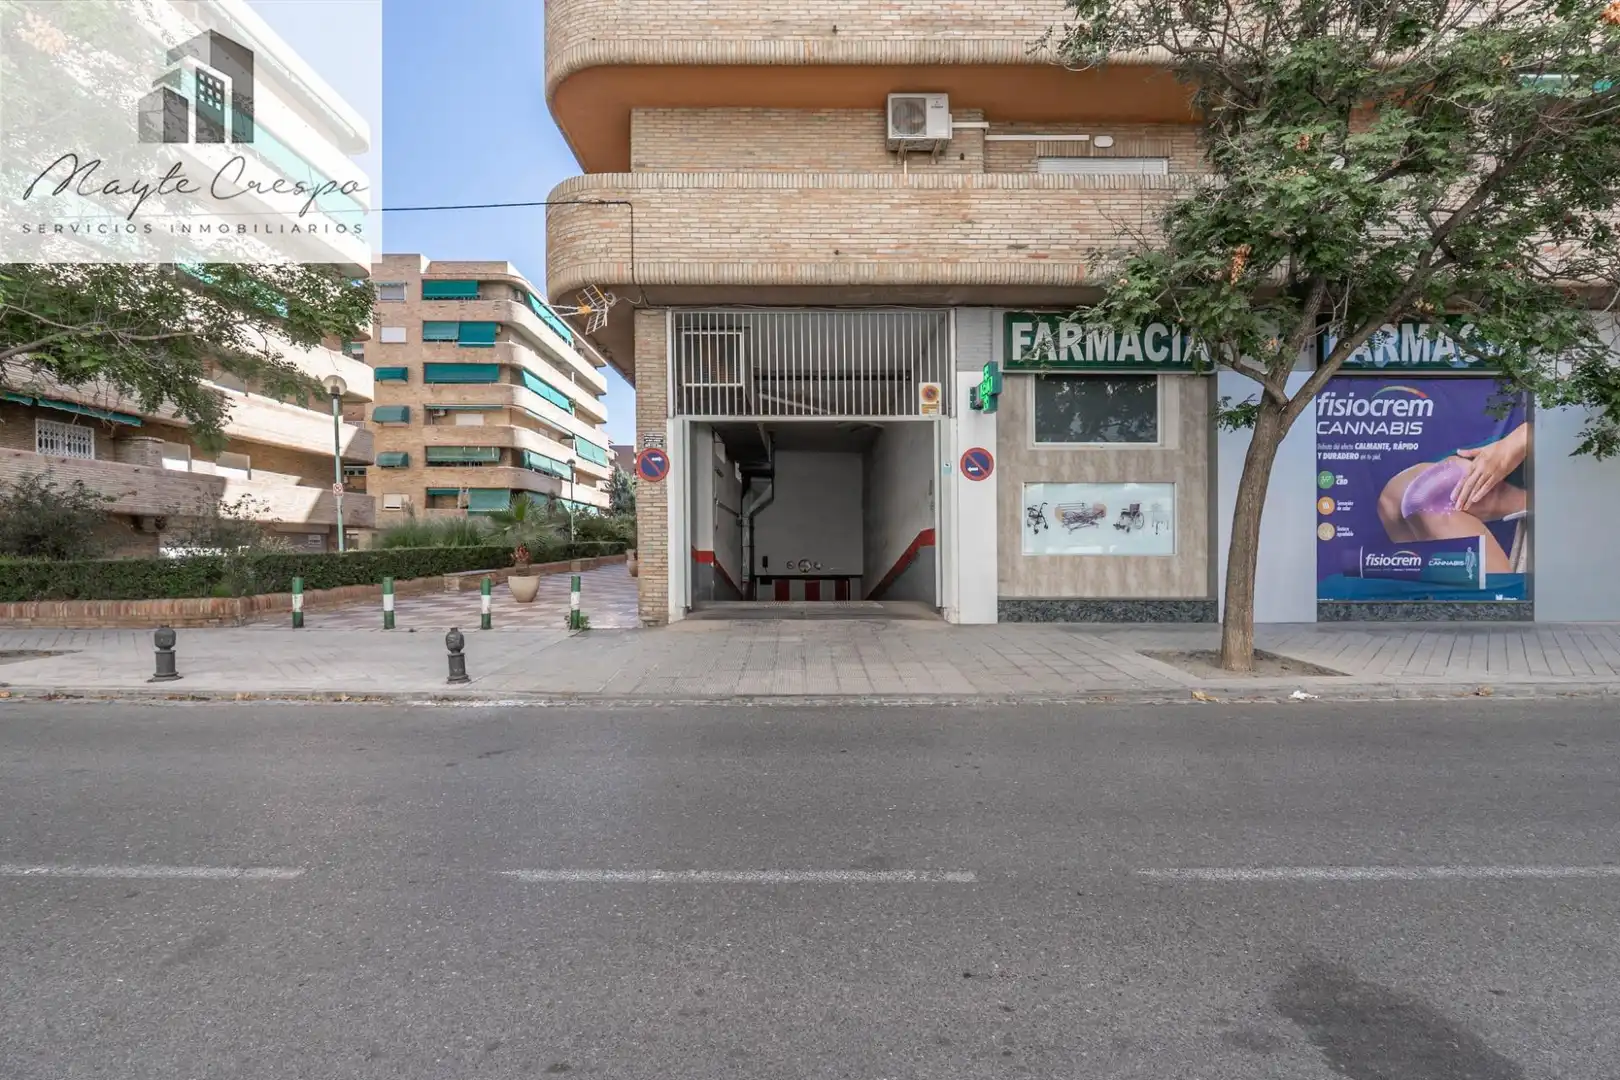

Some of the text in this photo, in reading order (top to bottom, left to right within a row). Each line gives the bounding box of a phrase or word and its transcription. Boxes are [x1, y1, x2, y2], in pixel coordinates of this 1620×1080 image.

[1317, 391, 1434, 417] fisiocrem
[1316, 420, 1424, 436] CANNABIS
[1365, 553, 1422, 566] fisiocrem
